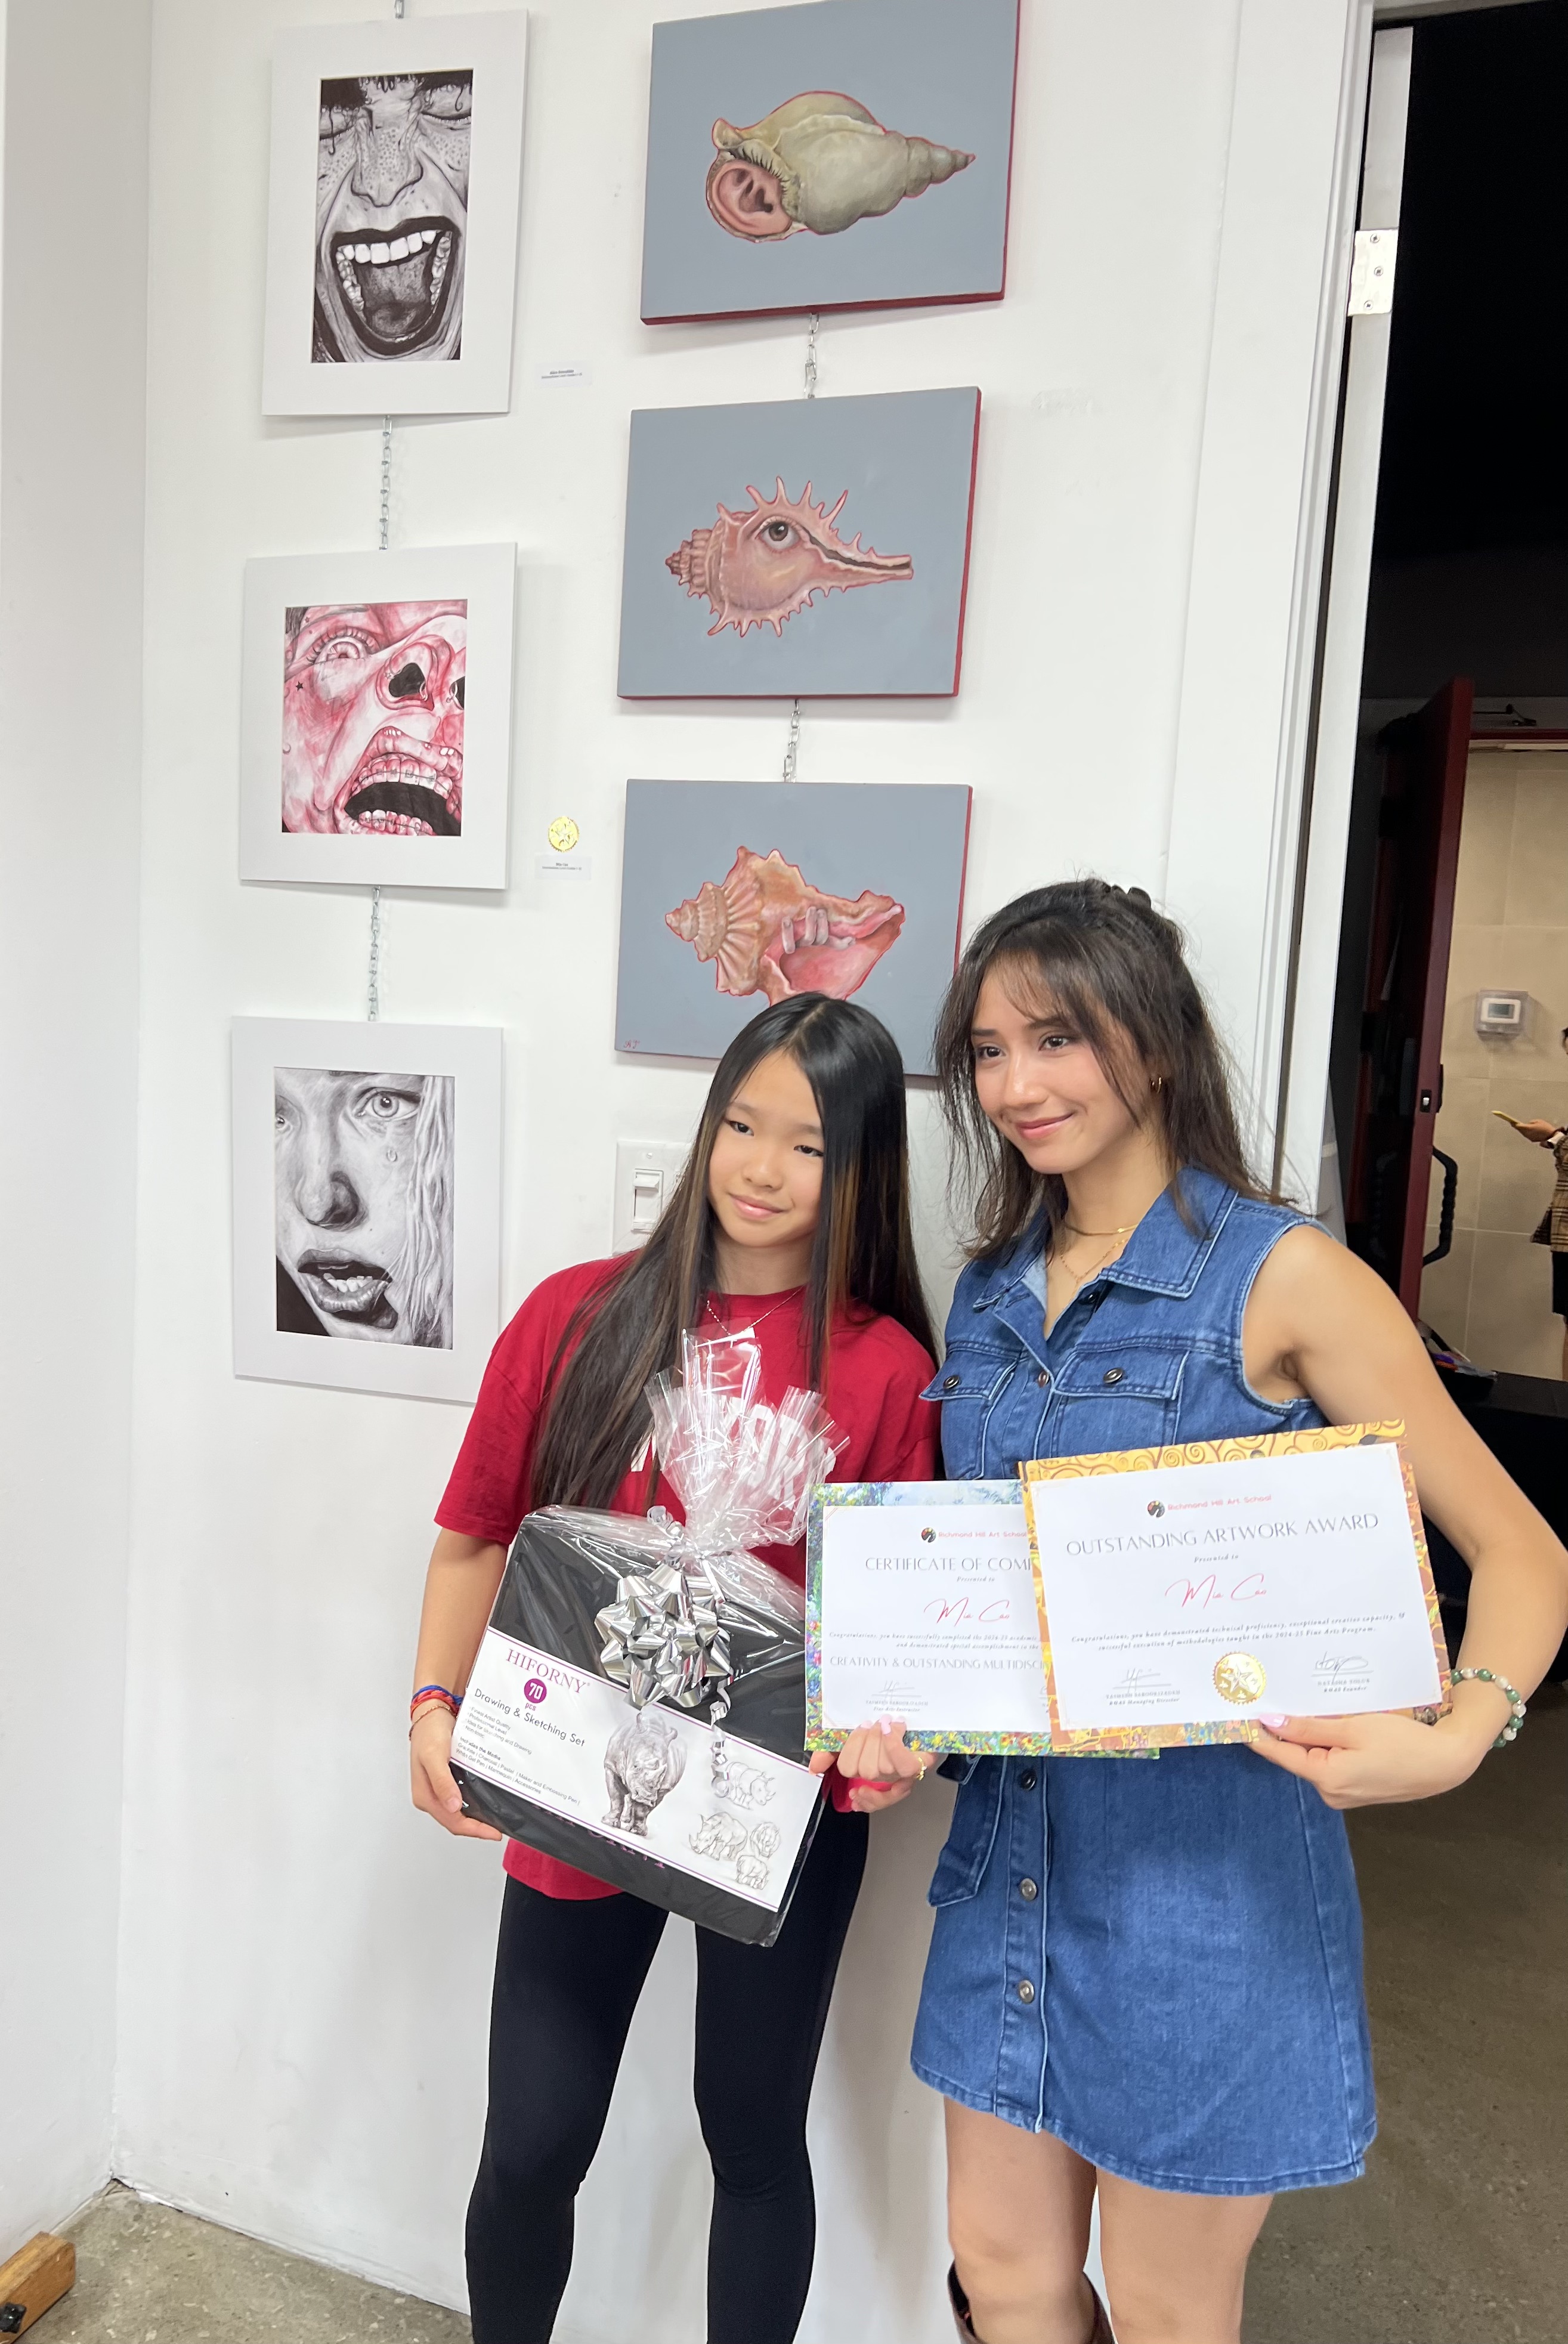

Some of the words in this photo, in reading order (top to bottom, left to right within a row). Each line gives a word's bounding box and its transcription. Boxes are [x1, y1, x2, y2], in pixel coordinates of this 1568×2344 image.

[1168, 1500, 1208, 1511] Richmond
[1244, 1495, 1272, 1503] School
[1066, 1530, 1196, 1556] OUTSTANDING
[1204, 1521, 1298, 1542] ARTWORK
[1306, 1513, 1378, 1535] AWARD
[865, 1557, 955, 1571] CERTIFICATE
[961, 1557, 983, 1571] OF
[988, 1557, 1031, 1572] COM
[1194, 1554, 1229, 1563] Presented
[907, 1632, 940, 1641] successfully
[1131, 1632, 1143, 1641] you
[1212, 1624, 1244, 1632] technical
[1289, 1618, 1329, 1628] exceptional
[1331, 1616, 1360, 1625] creative
[1099, 1640, 1131, 1652] successful
[1167, 1640, 1175, 1648] of
[1177, 1636, 1224, 1646] methodologies
[506, 1649, 586, 1693] HIFORNY
[830, 1656, 889, 1668] CREATIVITY
[892, 1658, 900, 1667] &
[903, 1658, 981, 1670] OUTSTANDING
[984, 1659, 1045, 1671] MULTIDISCI
[530, 1682, 544, 1700] 70
[524, 1702, 537, 1711] pcs
[1128, 1698, 1155, 1706] Managing
[469, 1713, 494, 1730] Professional
[494, 1725, 508, 1735] Level
[471, 1706, 484, 1717] Finest
[496, 1718, 511, 1730] Quality
[475, 1688, 511, 1715] Drawing
[514, 1708, 521, 1718] &
[524, 1712, 567, 1740] Sketching
[570, 1733, 586, 1747] Set
[505, 1737, 514, 1746] and
[514, 1740, 533, 1755] Drawing
[487, 1750, 501, 1761] Media
[477, 1758, 485, 1767] Pen
[488, 1764, 512, 1782] Mannequin
[515, 1777, 542, 1794] Accessories
[478, 1752, 497, 1767] Charcoal
[500, 1762, 515, 1774] Pastel
[533, 1779, 542, 1788] and
[542, 1783, 567, 1801] Embossing
[567, 1793, 578, 1804] Pen
